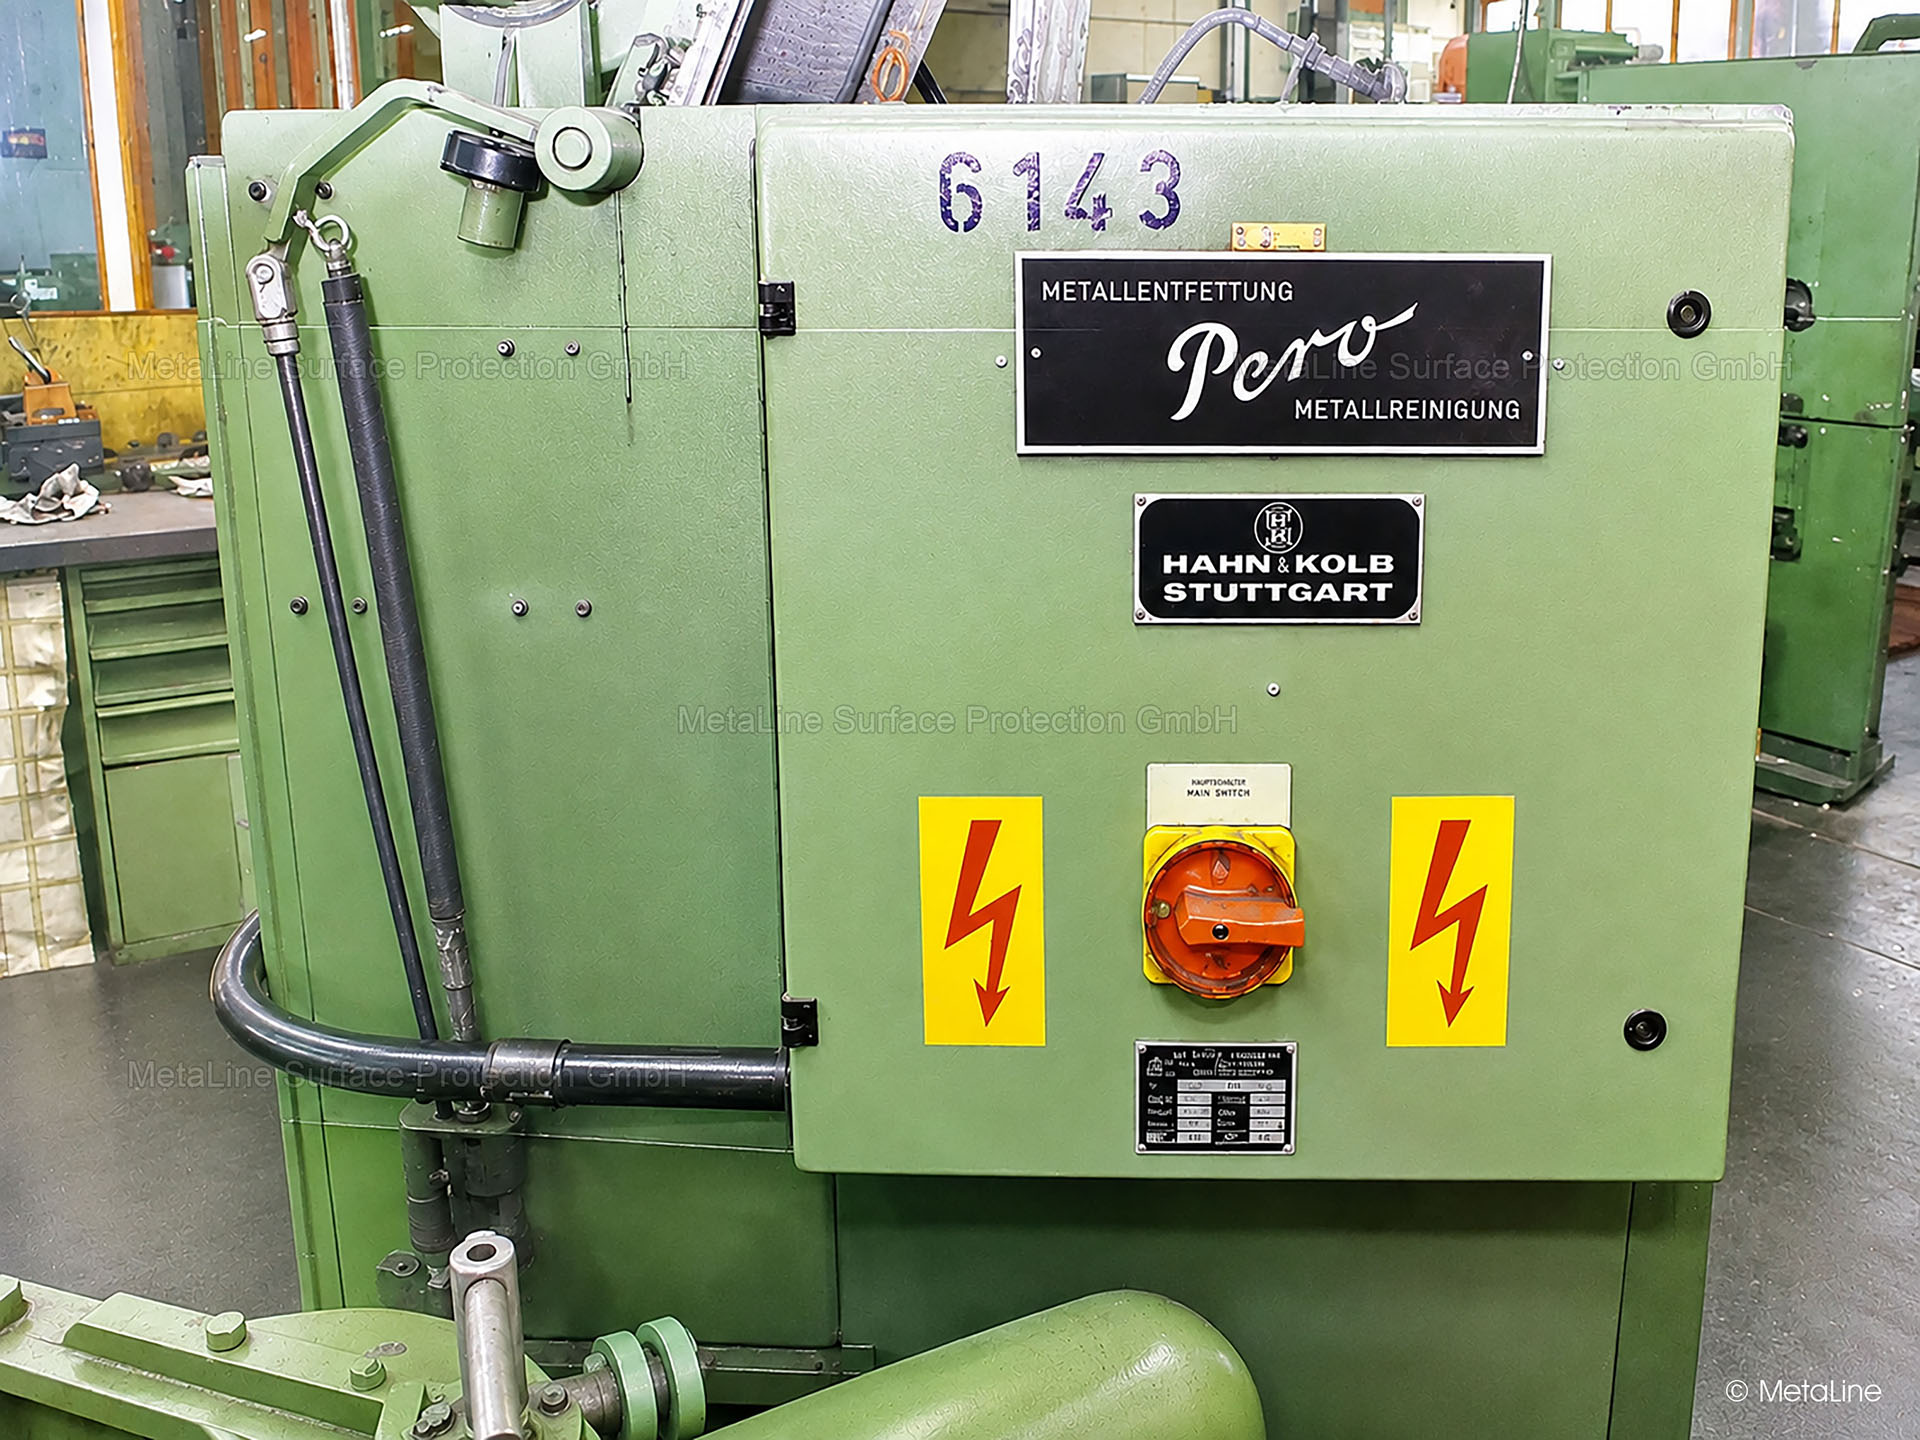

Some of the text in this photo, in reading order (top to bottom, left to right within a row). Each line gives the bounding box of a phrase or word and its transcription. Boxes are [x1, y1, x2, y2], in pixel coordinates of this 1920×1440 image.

[939, 149, 1182, 233] 6143
[1041, 280, 1294, 303] METALLENTFETTUNG
[1166, 302, 1418, 421] Pero
[1294, 399, 1521, 421] METALLREINIGUNG
[1162, 554, 1395, 575] HAHN & KOLB
[1163, 582, 1393, 603] STUTTGART
[1186, 788, 1251, 798] MAIN SWITCH
